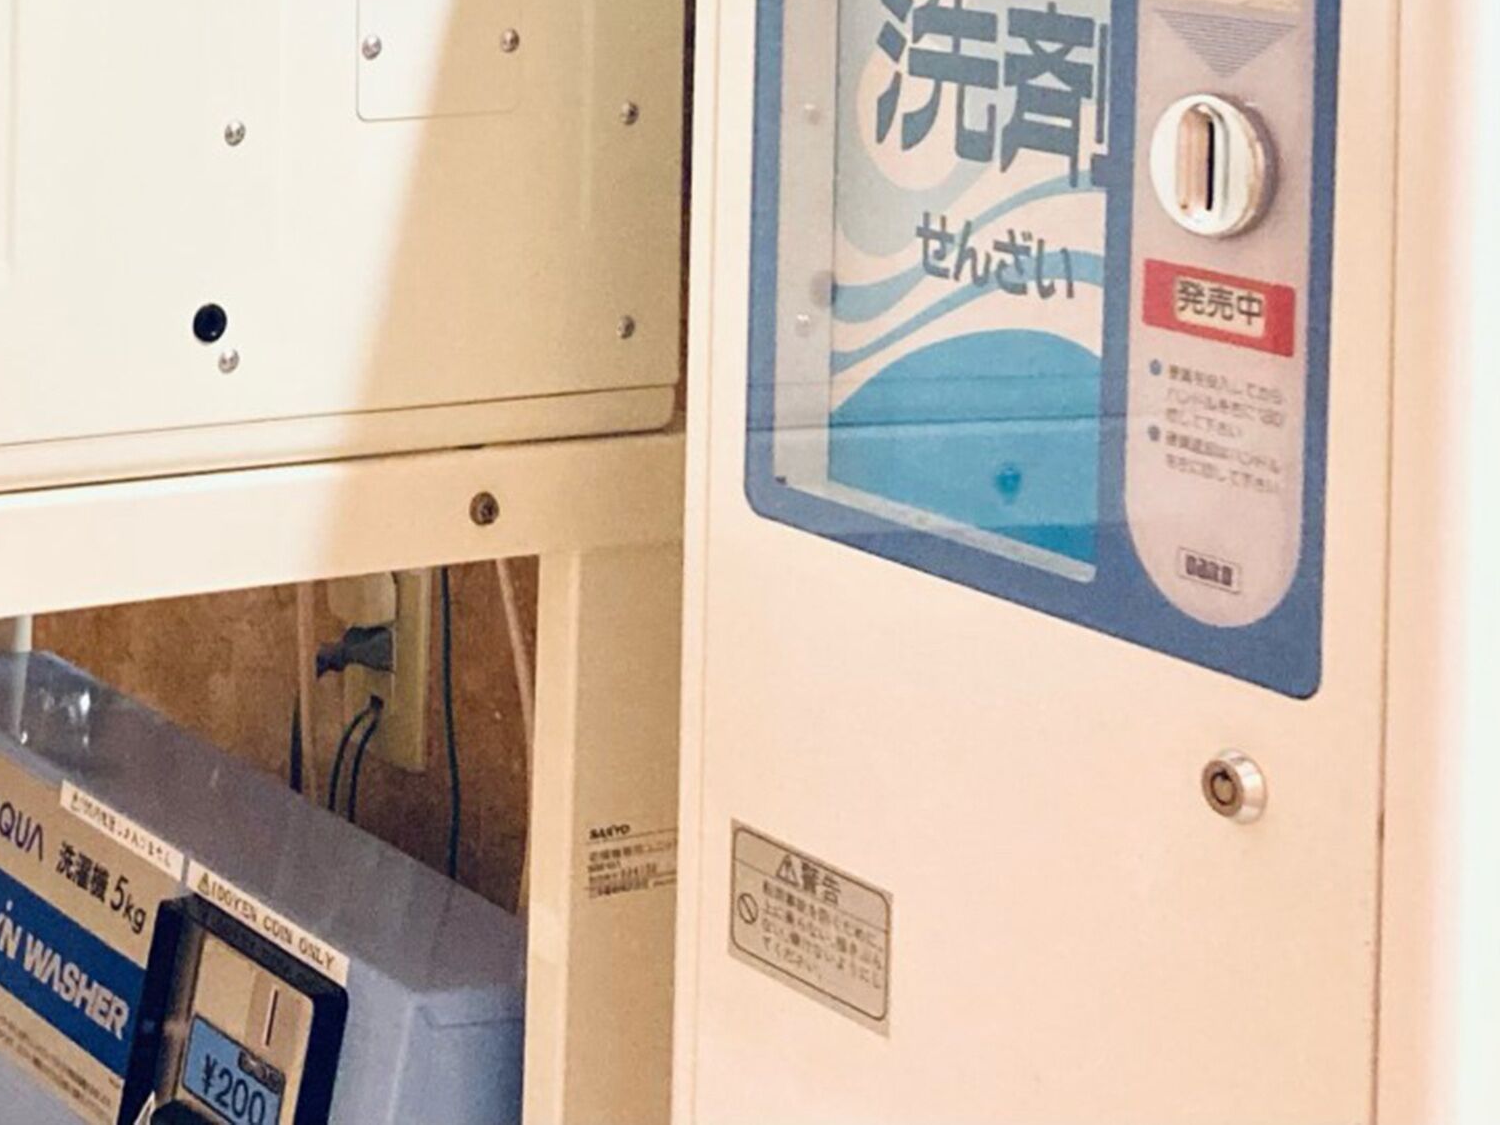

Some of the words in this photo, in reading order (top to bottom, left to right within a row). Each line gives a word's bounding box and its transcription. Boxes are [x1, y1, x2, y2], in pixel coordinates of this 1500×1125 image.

[915, 212, 1076, 300] せんざい
[1175, 278, 1265, 327] 発売中
[800, 861, 842, 906] 警告
[262, 916, 293, 945] COIN
[299, 935, 335, 971] ONLY
[23, 932, 131, 1041] WASHER
[202, 1053, 266, 1125] ¥200
